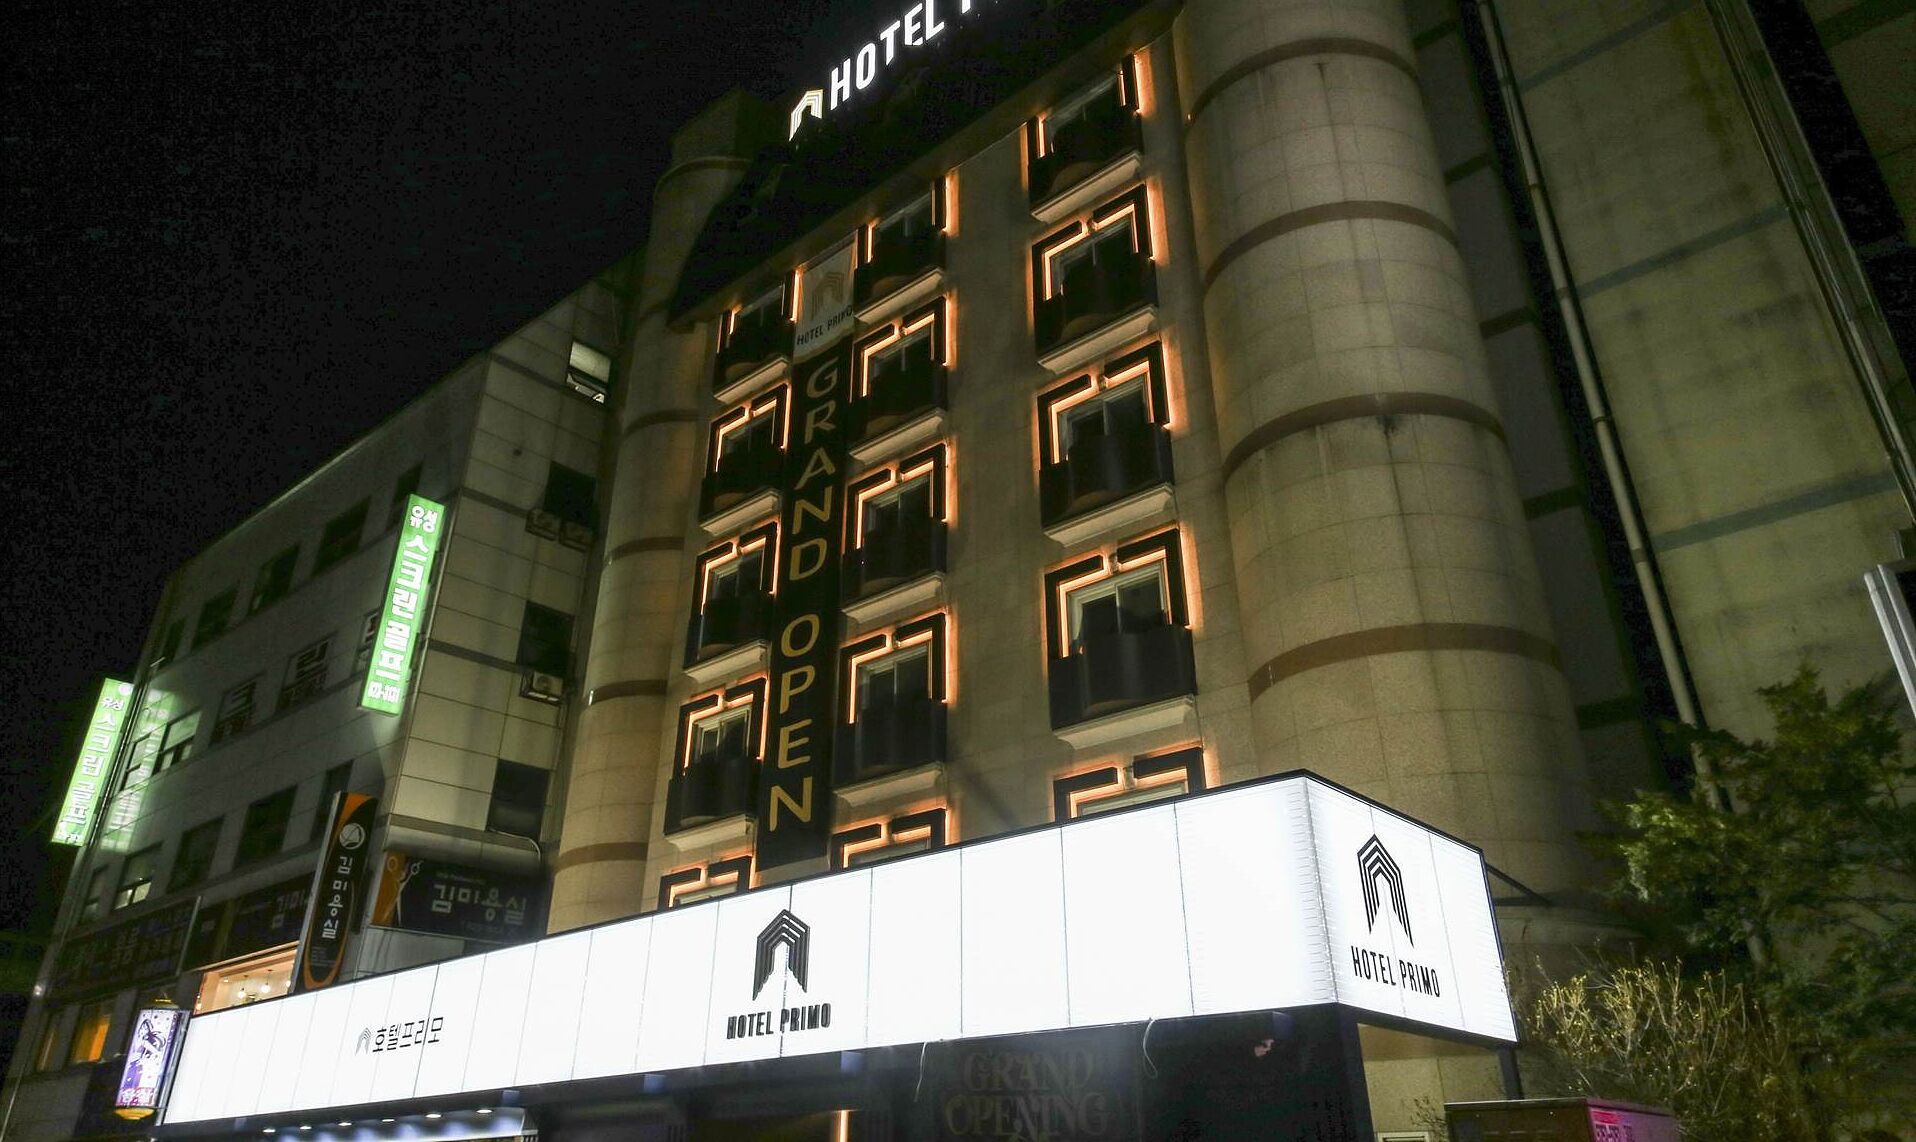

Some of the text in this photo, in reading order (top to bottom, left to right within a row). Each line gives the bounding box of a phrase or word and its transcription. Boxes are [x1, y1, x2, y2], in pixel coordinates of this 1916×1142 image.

[830, 0, 945, 111] HOTEL
[797, 323, 824, 345] HOTEL
[769, 356, 838, 832] GRAND OPEN
[431, 883, 526, 926] 김미용실
[1351, 946, 1440, 998] HOTEL PRIMO
[372, 1017, 443, 1053] 호텔프리모
[727, 1003, 831, 1040] HOTEL PRIMO
[964, 1048, 1094, 1091] GRAND
[944, 1093, 1110, 1140] OPENING
